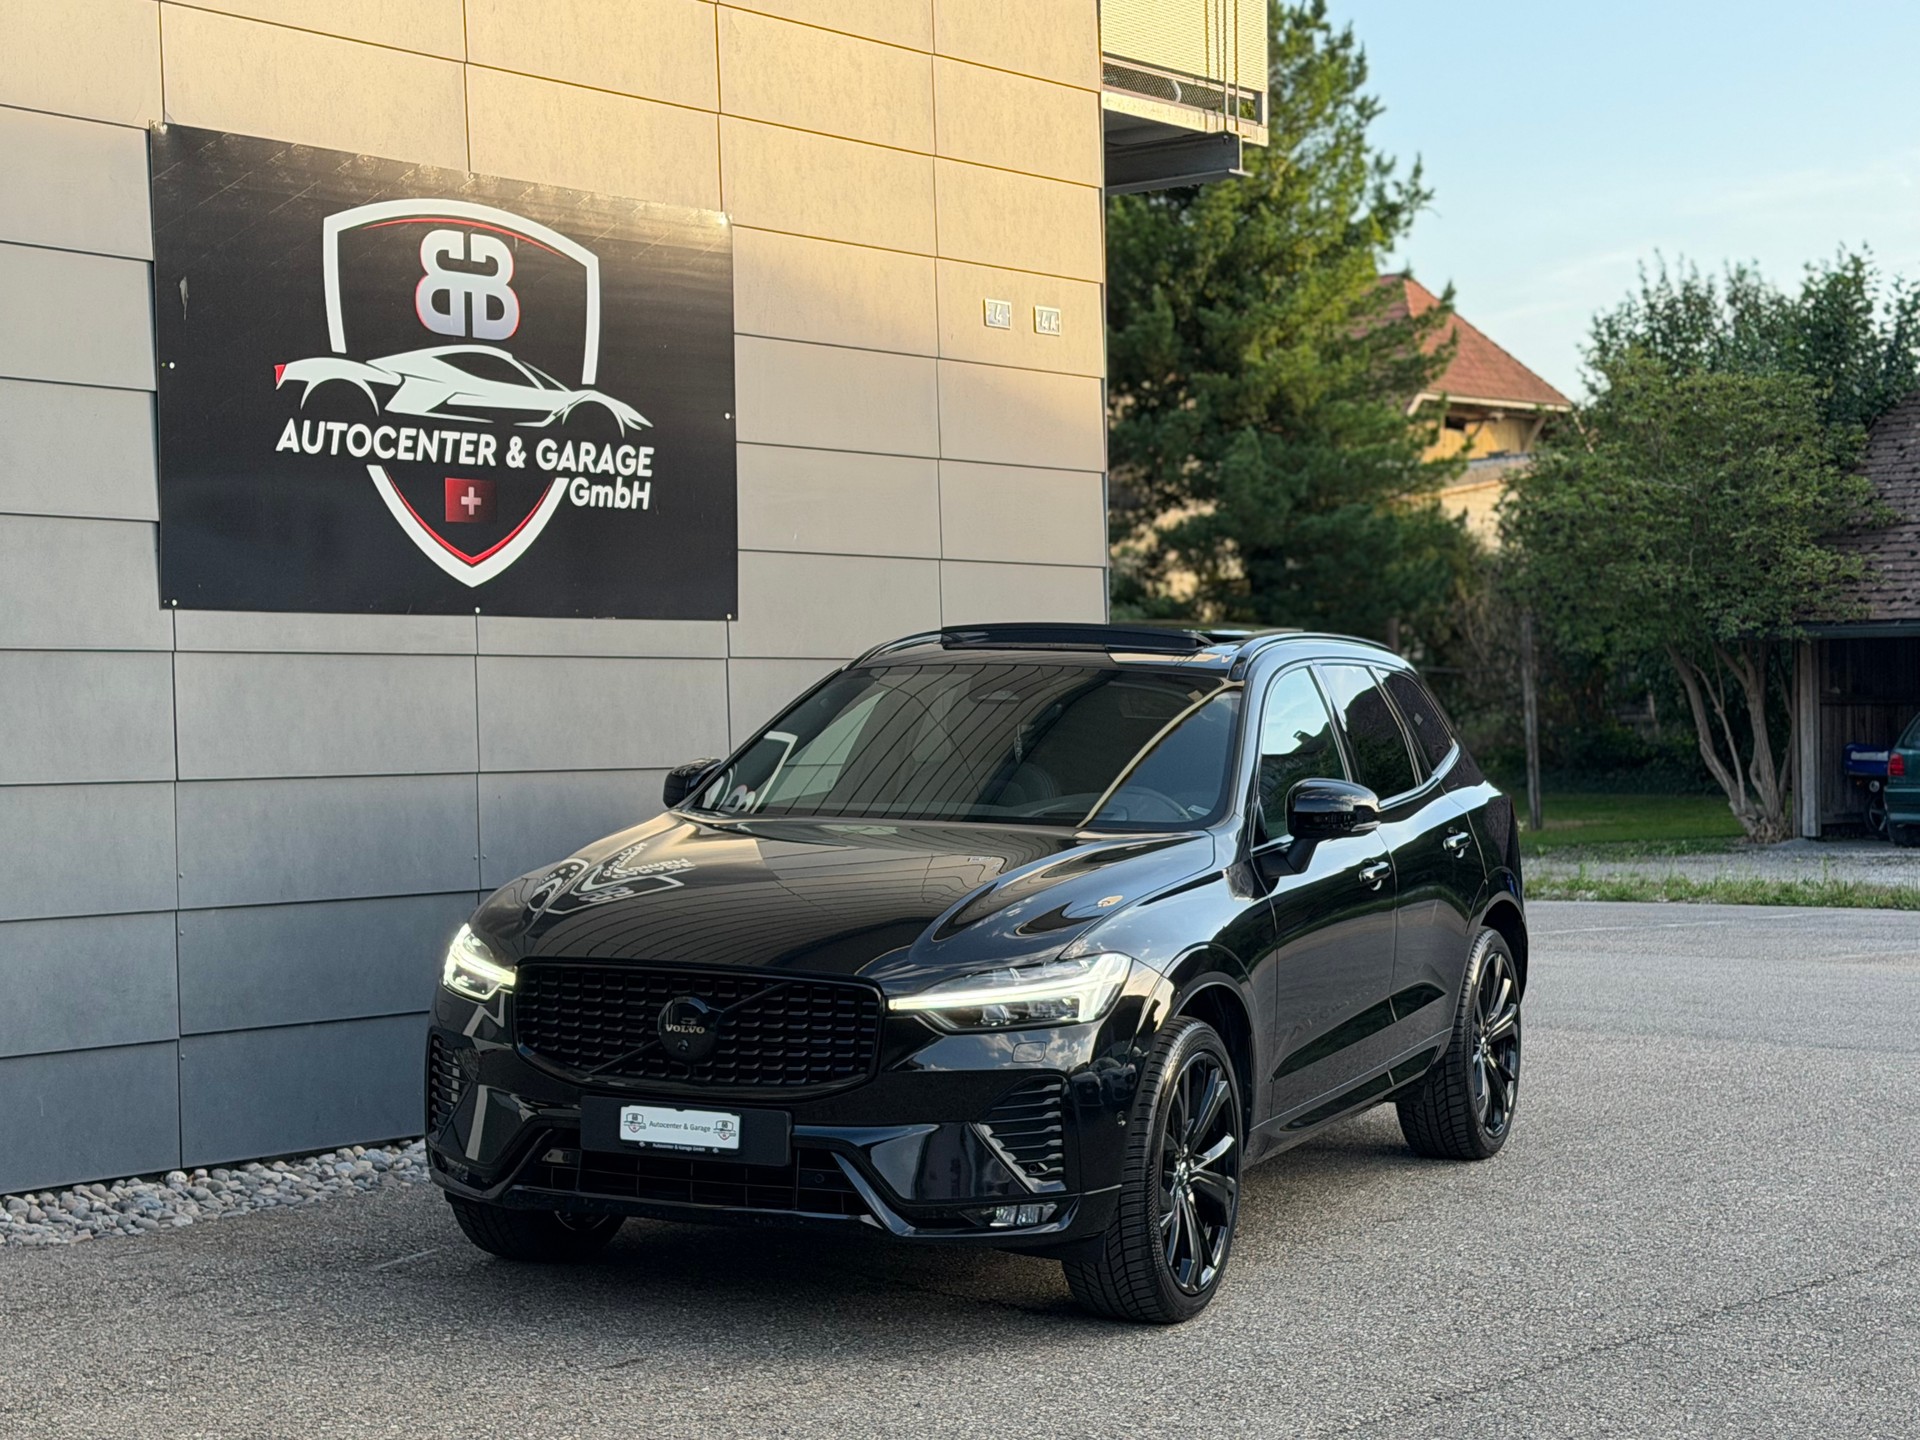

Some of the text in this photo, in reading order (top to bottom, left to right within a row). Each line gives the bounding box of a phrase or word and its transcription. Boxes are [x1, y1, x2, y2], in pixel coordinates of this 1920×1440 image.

[275, 417, 655, 477] AUTOCENTER & GARAGE
[569, 476, 651, 510] GmbH
[665, 1024, 705, 1034] VOLVO
[649, 1120, 682, 1130] Autocenter
[690, 1123, 711, 1133] Garage
